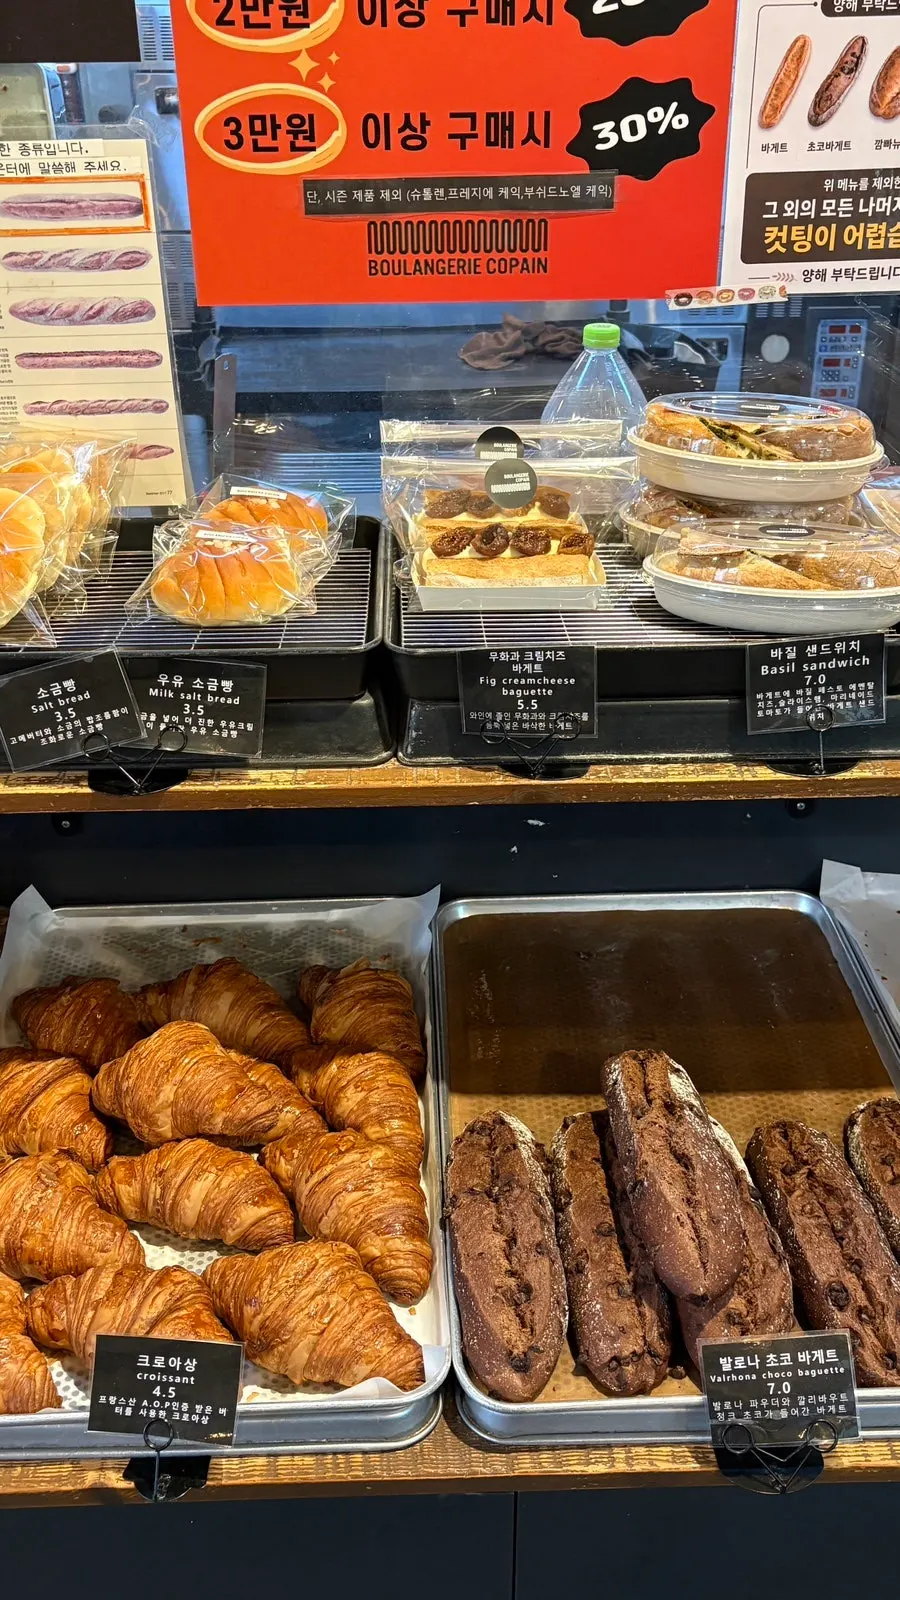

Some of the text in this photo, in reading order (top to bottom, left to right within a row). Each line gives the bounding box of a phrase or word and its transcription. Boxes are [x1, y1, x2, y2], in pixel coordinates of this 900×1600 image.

[358, 0, 426, 28] 이상
[447, 0, 553, 27] 구매시
[223, 111, 551, 152] 3만원 이상 구매시
[592, 101, 690, 150] 30%
[18, 141, 89, 157] 종류입니다.
[761, 142, 788, 154] 바게트
[807, 140, 852, 152] 초코바게트
[38, 161, 76, 175] 말씀해
[84, 160, 127, 173] 주세요.
[823, 178, 834, 192] 위
[837, 178, 869, 191] 메뉴를
[306, 190, 321, 204] 단,
[325, 190, 348, 203] 시즌
[352, 189, 375, 202] 제품
[379, 188, 402, 202] 제외
[585, 184, 612, 199] 케익)
[762, 201, 779, 218] 그
[783, 199, 816, 219] 외의
[820, 198, 854, 218] 모든
[764, 223, 837, 254] 컷팅이
[368, 257, 548, 276] BOULANGERIE COPAIN
[802, 268, 827, 283] 양해
[489, 650, 566, 662] 무화과 크림치즈
[770, 640, 860, 660] 바질 샌드위치
[512, 663, 543, 674] 바게트
[761, 655, 870, 676] Basil sandwich
[157, 673, 234, 693] 우유 소금빵
[479, 676, 576, 686] Fig creamcheese
[804, 674, 826, 685] 7.0
[37, 679, 77, 700] 소금빵
[149, 688, 240, 705] Milk salt bread
[502, 688, 553, 698] baguette
[756, 690, 791, 700] 바게트에
[796, 687, 812, 696] 바질
[31, 690, 91, 714] Salt bread
[517, 700, 538, 710] 5.5
[54, 708, 76, 722] 3.5
[183, 703, 205, 716] 3.5
[469, 711, 493, 721] 와인에
[514, 711, 546, 721] 무화과와
[757, 707, 791, 718] 토마토가
[184, 716, 193, 724] 더
[522, 721, 546, 731] 바삭한
[79, 722, 104, 735] 소금빵
[190, 726, 207, 735] 우유
[212, 729, 238, 739] 소금빵
[136, 1354, 198, 1372] 크로아상
[719, 1349, 839, 1371] 발로나 초코 바게트
[136, 1372, 195, 1385] croissant
[710, 1366, 845, 1383] Valrhona choco baguette
[152, 1386, 176, 1398] 4.5
[767, 1382, 791, 1395] 7.0
[98, 1395, 227, 1417] 프랑스산 A.O.P인증 받은 버
[713, 1400, 743, 1411] 발로나
[749, 1397, 791, 1408] 파우더와
[114, 1406, 210, 1424] 터를 사용한 크로아상
[744, 1408, 774, 1420] 초코가
[780, 1405, 810, 1419] 들어간
[817, 1404, 847, 1415] 바게트
